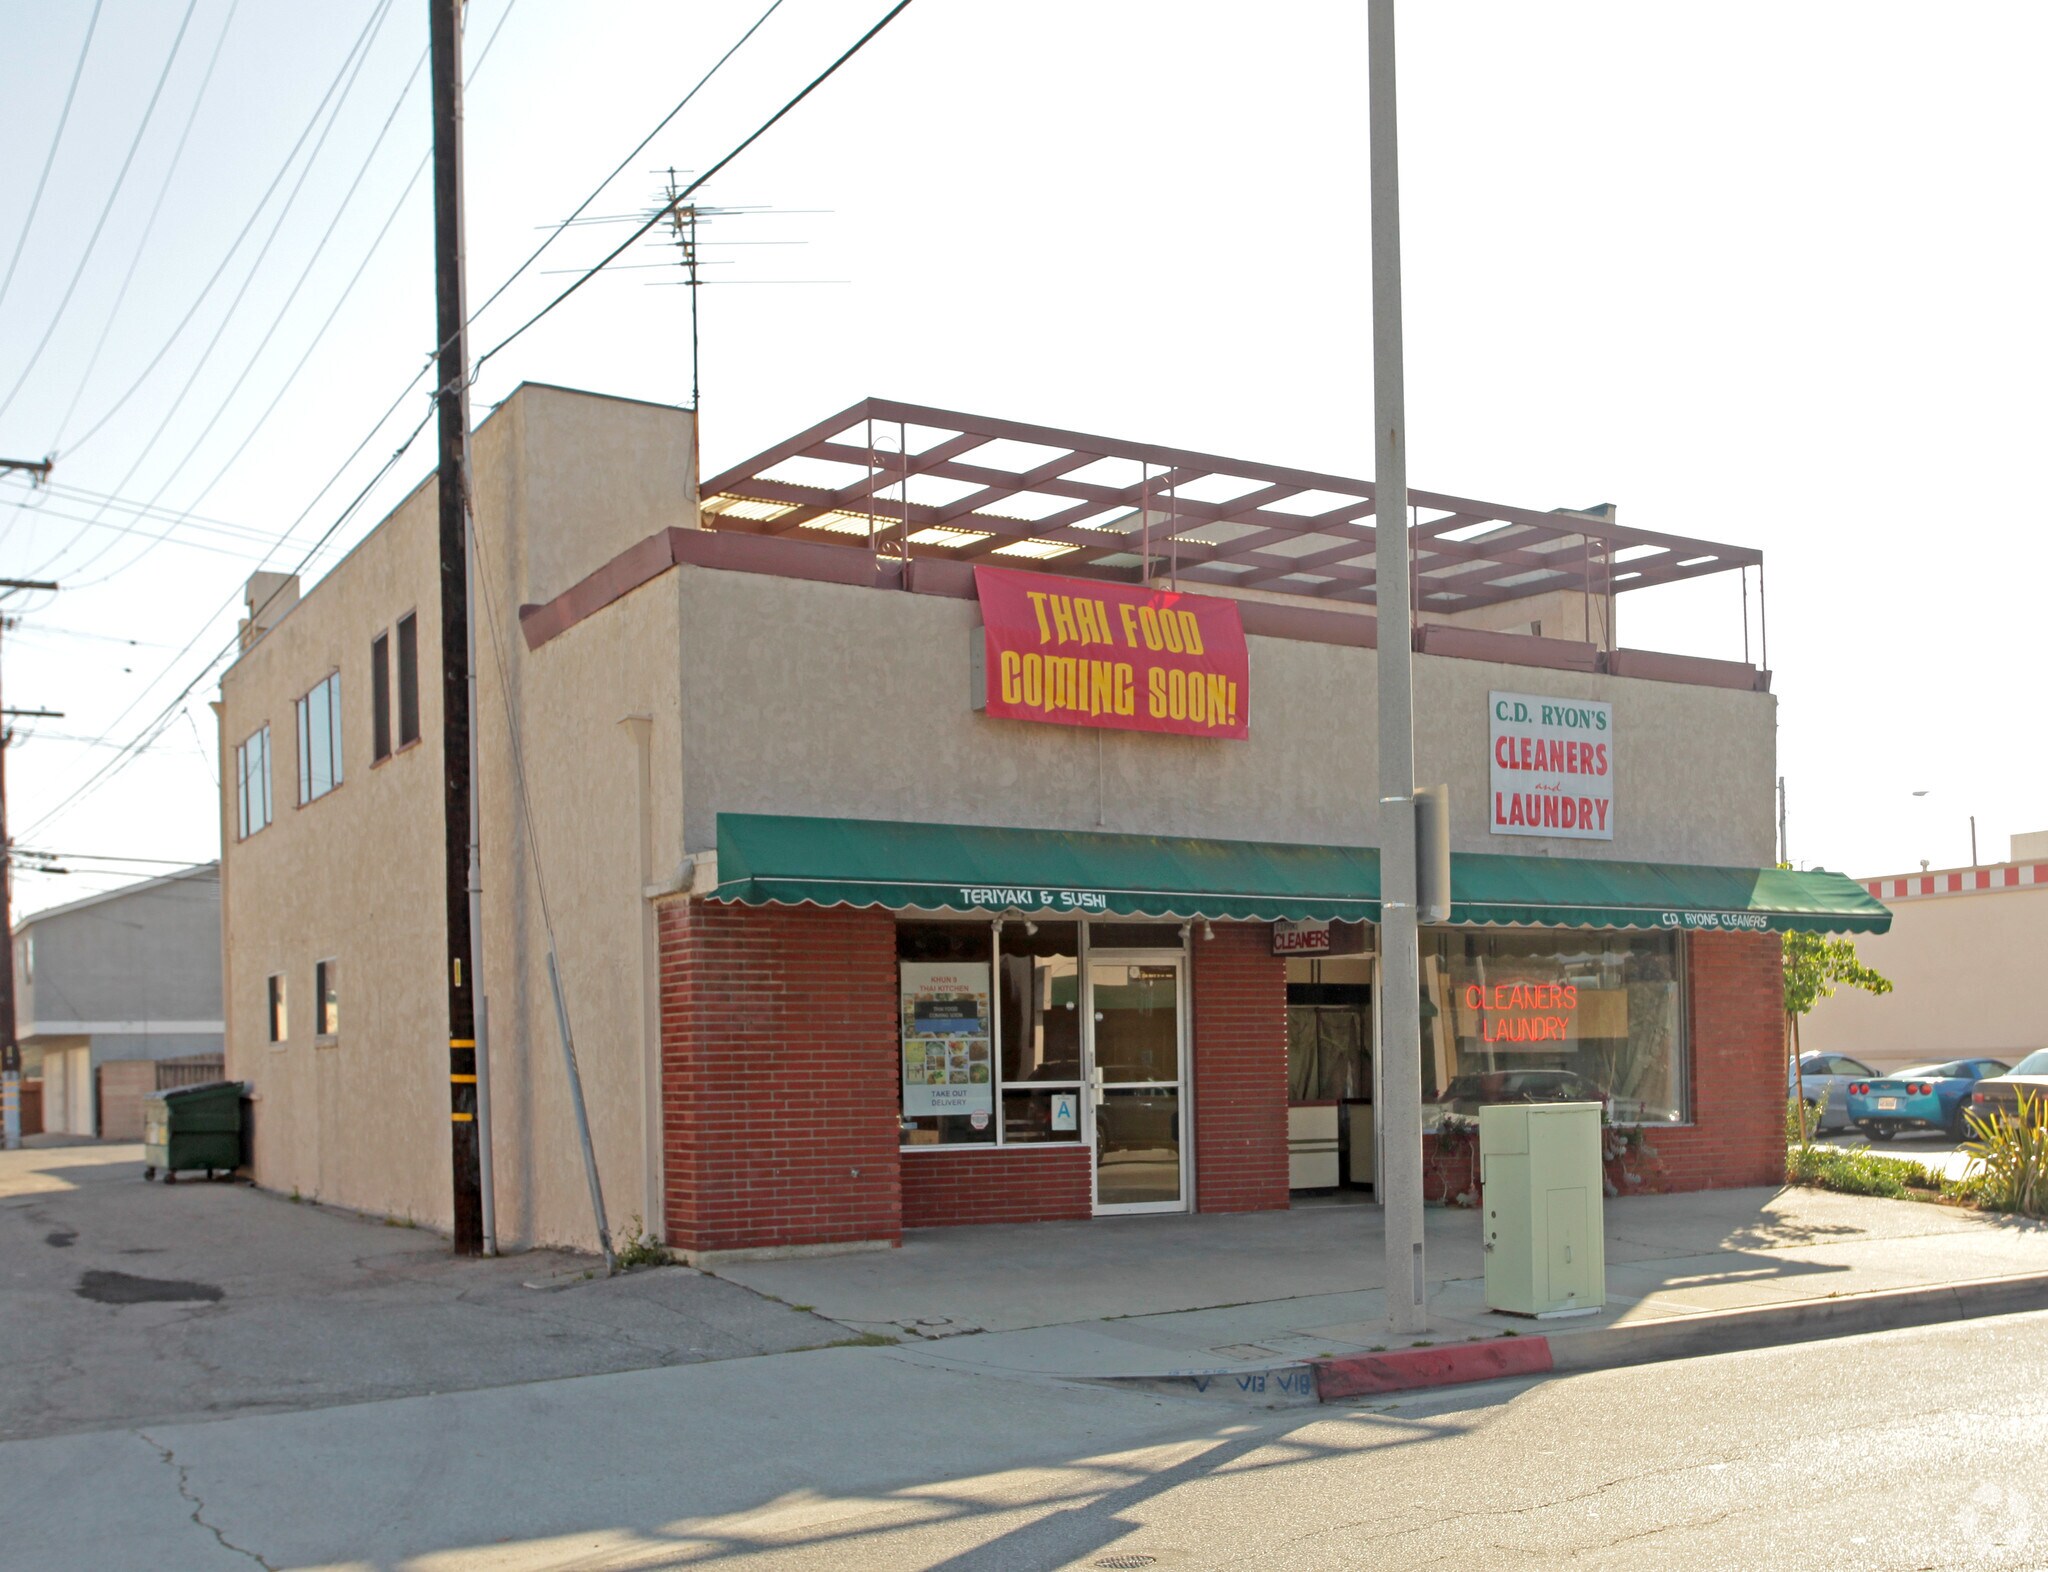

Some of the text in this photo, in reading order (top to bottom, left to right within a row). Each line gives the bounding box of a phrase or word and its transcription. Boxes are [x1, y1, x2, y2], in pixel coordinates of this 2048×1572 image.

[1026, 591, 1204, 655] THAI FOOD
[1000, 651, 1237, 728] COMING SOON!
[1496, 701, 1607, 730] C.D. RYON'S
[1495, 735, 1608, 776] CLEANERS
[1535, 781, 1562, 792] and
[1496, 792, 1609, 831] LAUNDRY
[960, 888, 1106, 908] TERIYAKI & SUSHI
[1721, 914, 1767, 928] CLEANERS
[1274, 930, 1329, 950] CLEANERS
[938, 984, 969, 992] KITCHEN
[1466, 984, 1577, 1010] CLEANERS
[1483, 1017, 1569, 1042] LAUNDRY
[1057, 1101, 1071, 1118] A
